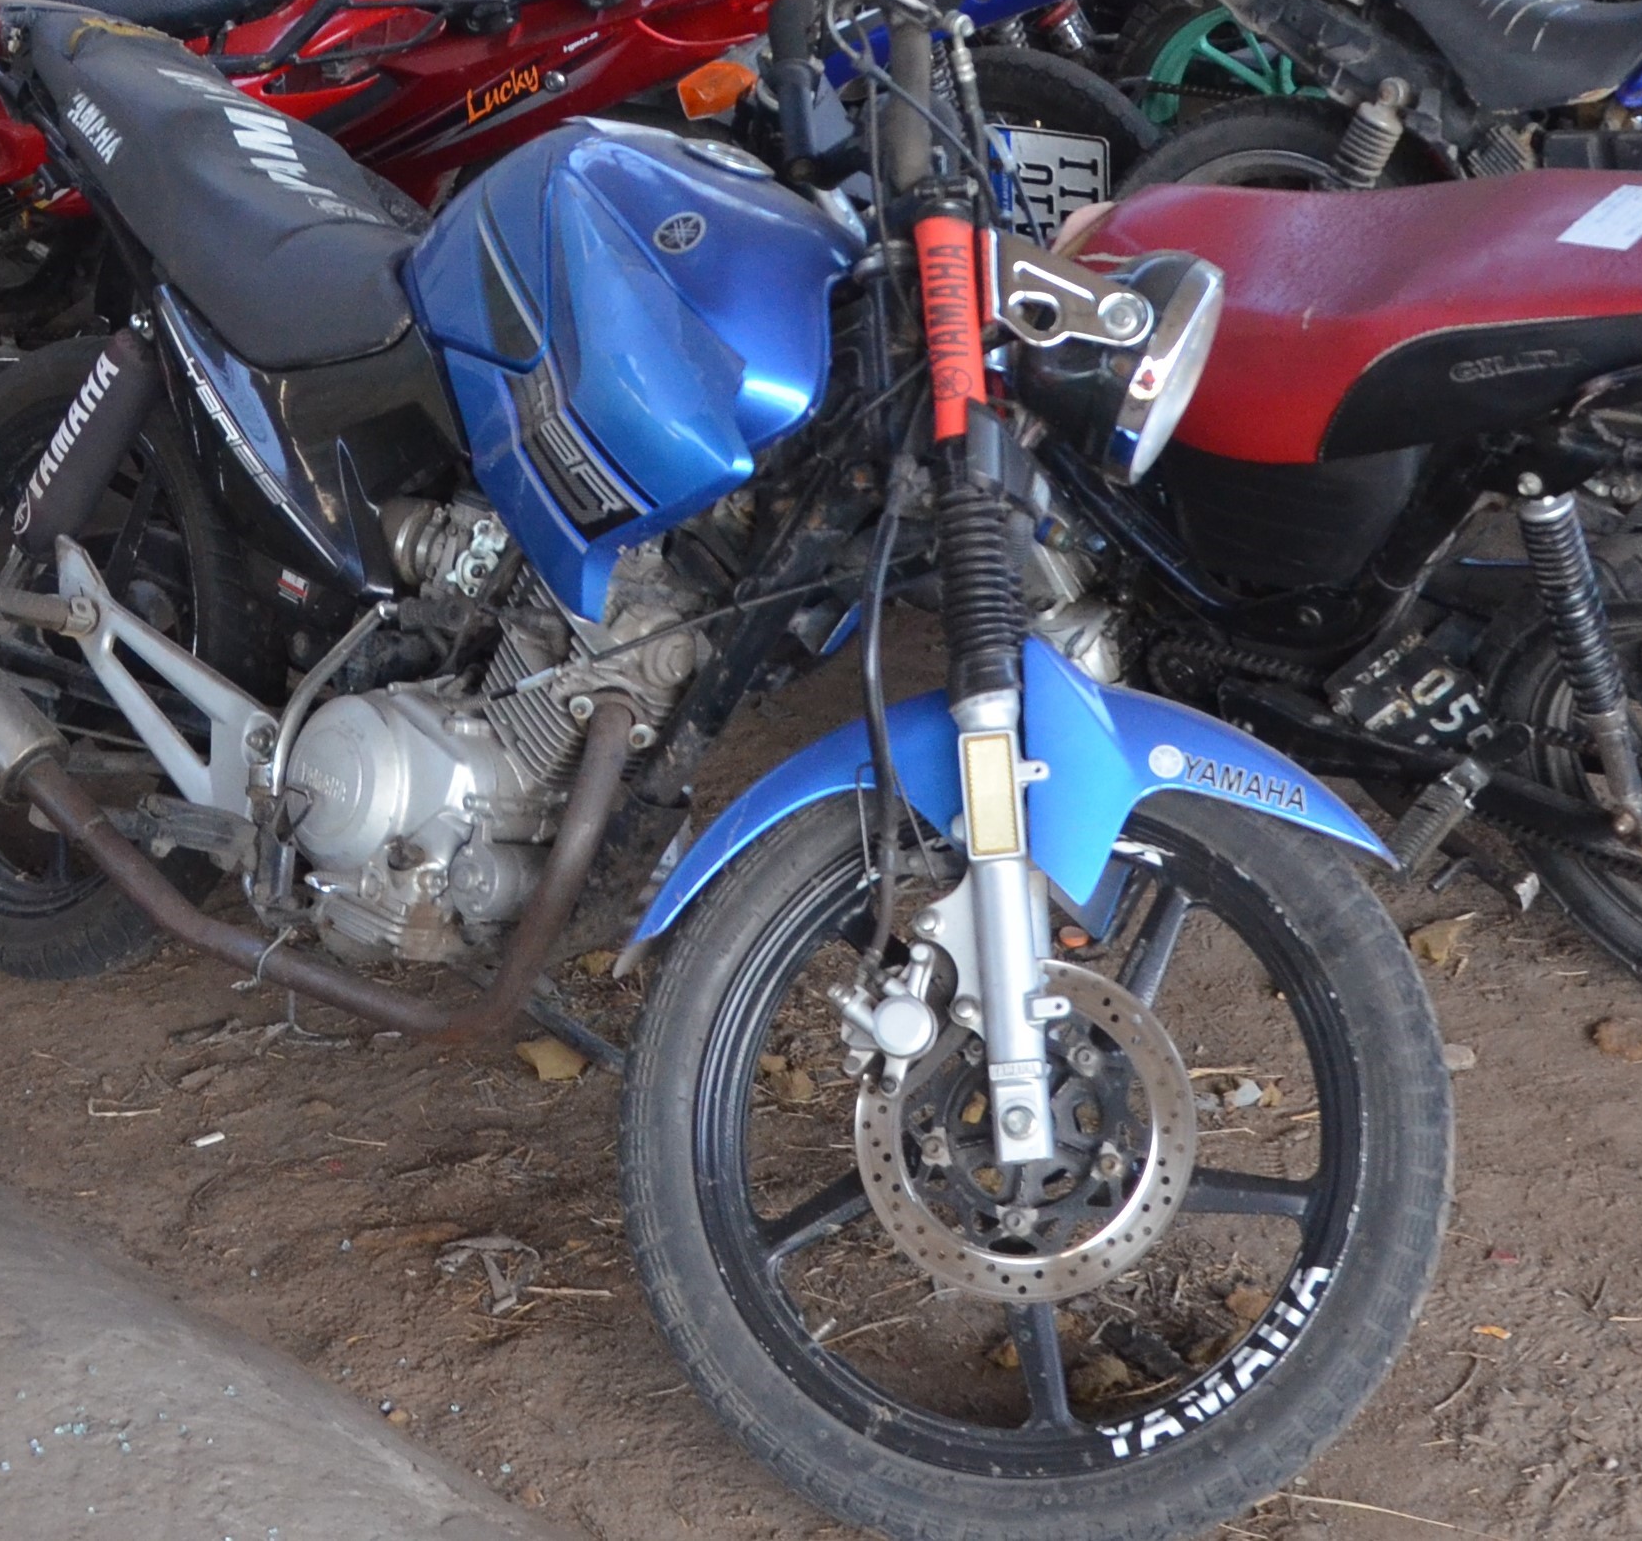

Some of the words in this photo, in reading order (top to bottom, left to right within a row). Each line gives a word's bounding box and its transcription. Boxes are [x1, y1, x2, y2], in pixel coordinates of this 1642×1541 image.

[465, 64, 541, 125] Lucky
[926, 244, 970, 364] YAMAHA
[28, 350, 121, 500] YAMAHA
[1182, 753, 1307, 814] YAMAHA
[1095, 1265, 1331, 1458] YAMAHA
